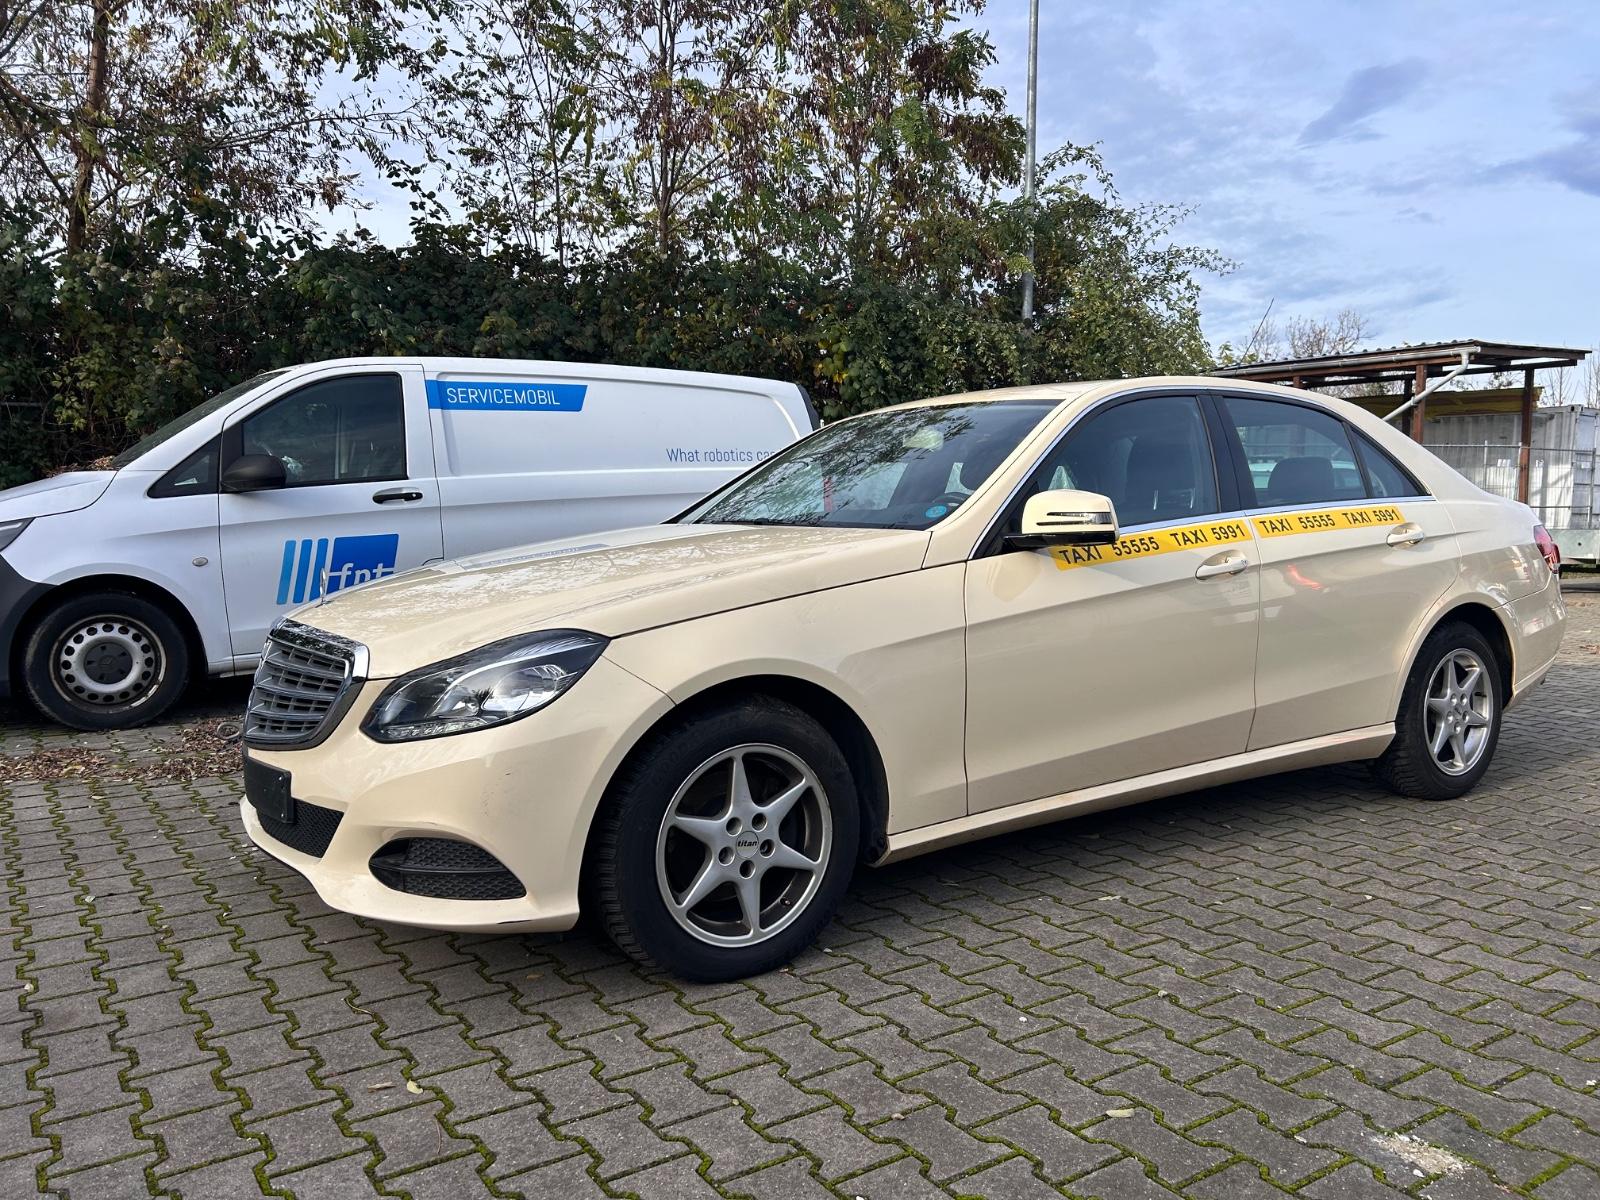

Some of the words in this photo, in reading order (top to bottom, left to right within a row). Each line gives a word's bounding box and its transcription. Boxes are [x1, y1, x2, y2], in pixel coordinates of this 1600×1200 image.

[446, 387, 560, 405] SERVICEMOBIL
[666, 448, 700, 462] What
[704, 447, 753, 462] robotics
[756, 451, 775, 462] ca
[1259, 518, 1293, 534] TAXI
[1298, 514, 1336, 529] 55555
[1342, 511, 1371, 525] TAXI
[1373, 508, 1400, 522] 5991
[1059, 545, 1102, 565] TAXI
[1112, 536, 1160, 556] 55555
[1170, 529, 1208, 547] TAXI
[1212, 524, 1246, 541] 5991
[737, 839, 758, 847] titan
